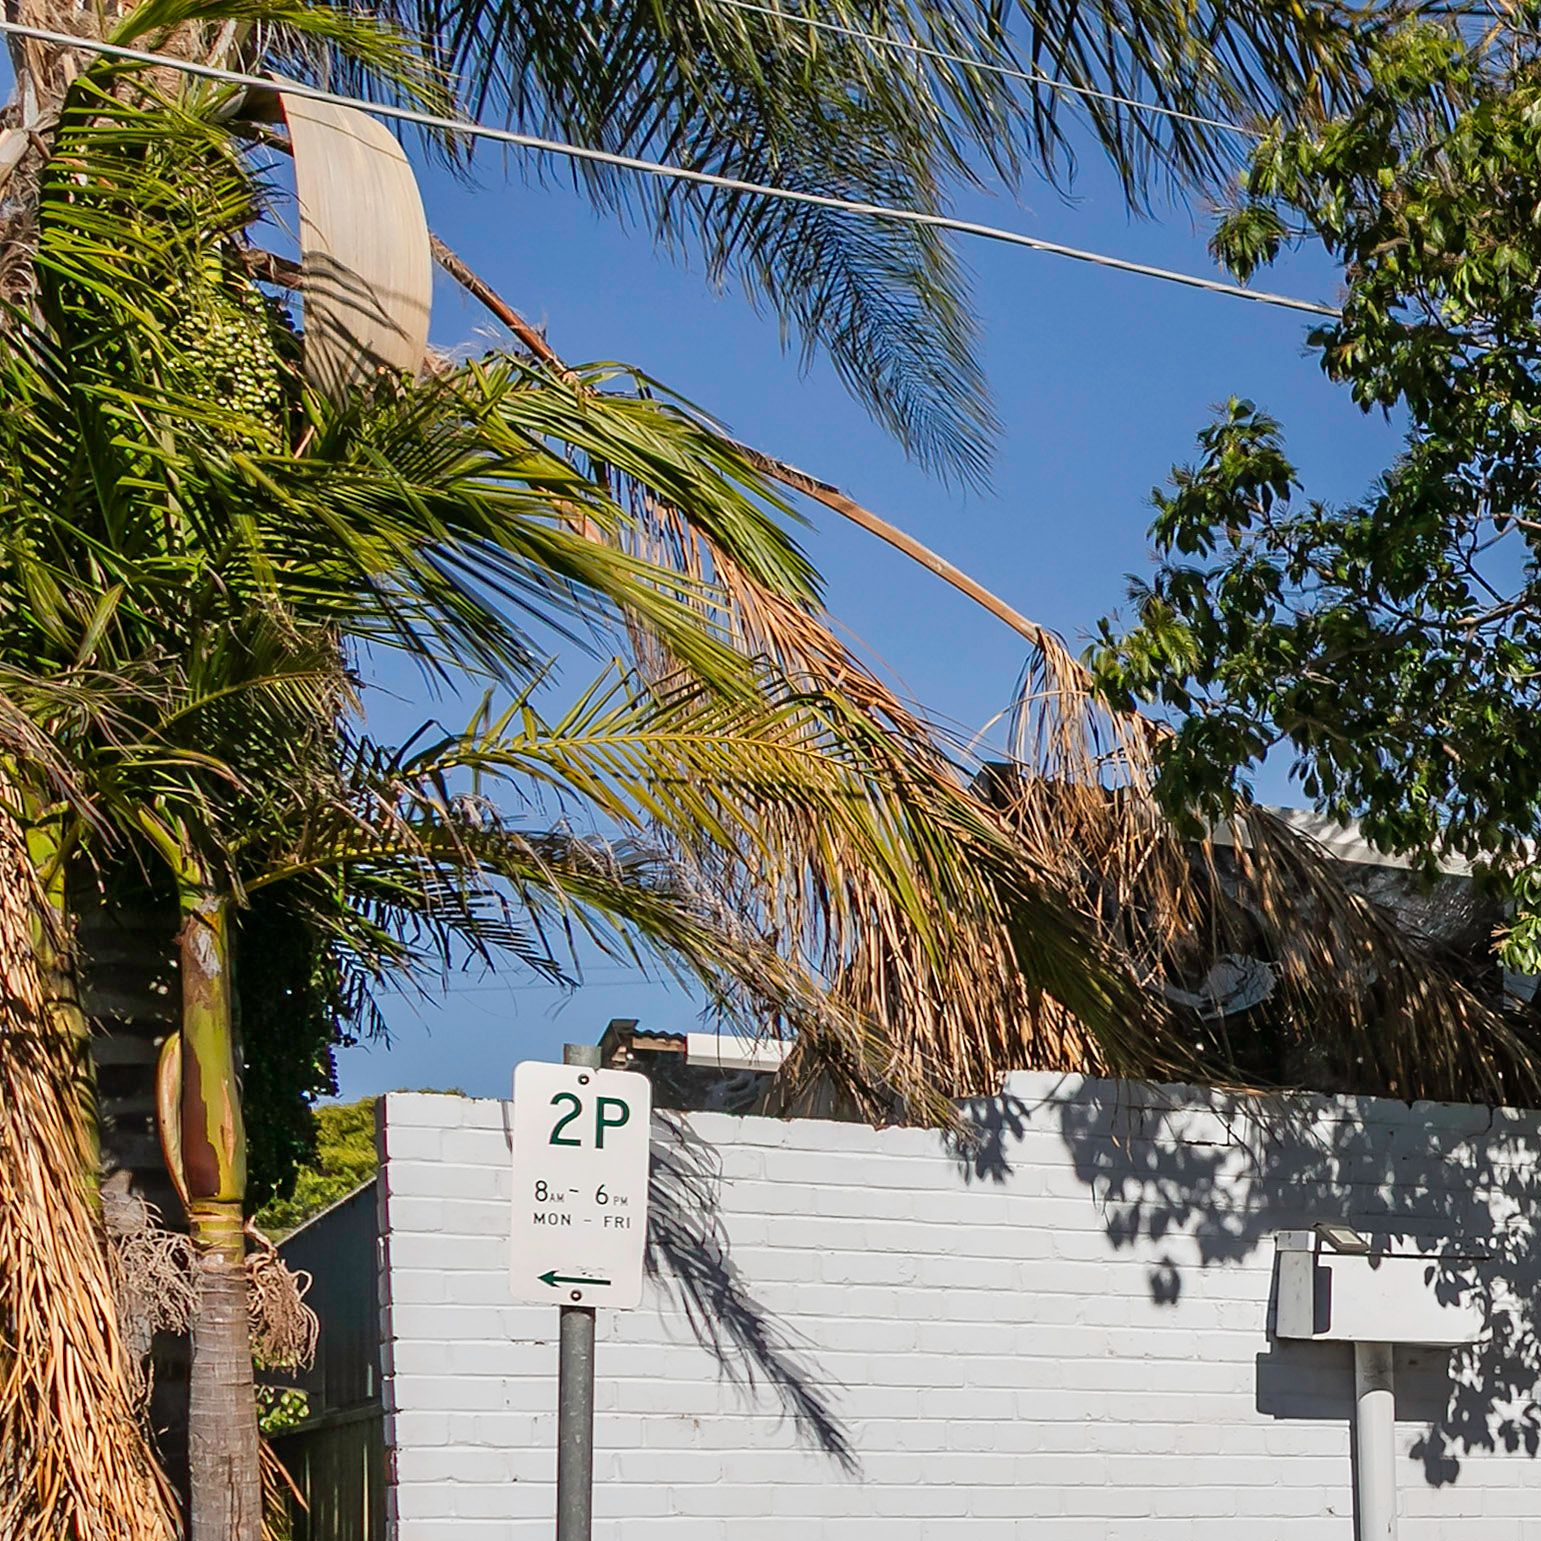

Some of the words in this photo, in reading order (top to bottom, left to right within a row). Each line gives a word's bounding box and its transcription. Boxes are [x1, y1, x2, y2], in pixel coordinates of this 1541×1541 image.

[549, 1091, 630, 1150] 2P
[533, 1212, 571, 1226] MON
[604, 1215, 631, 1229] FRI
